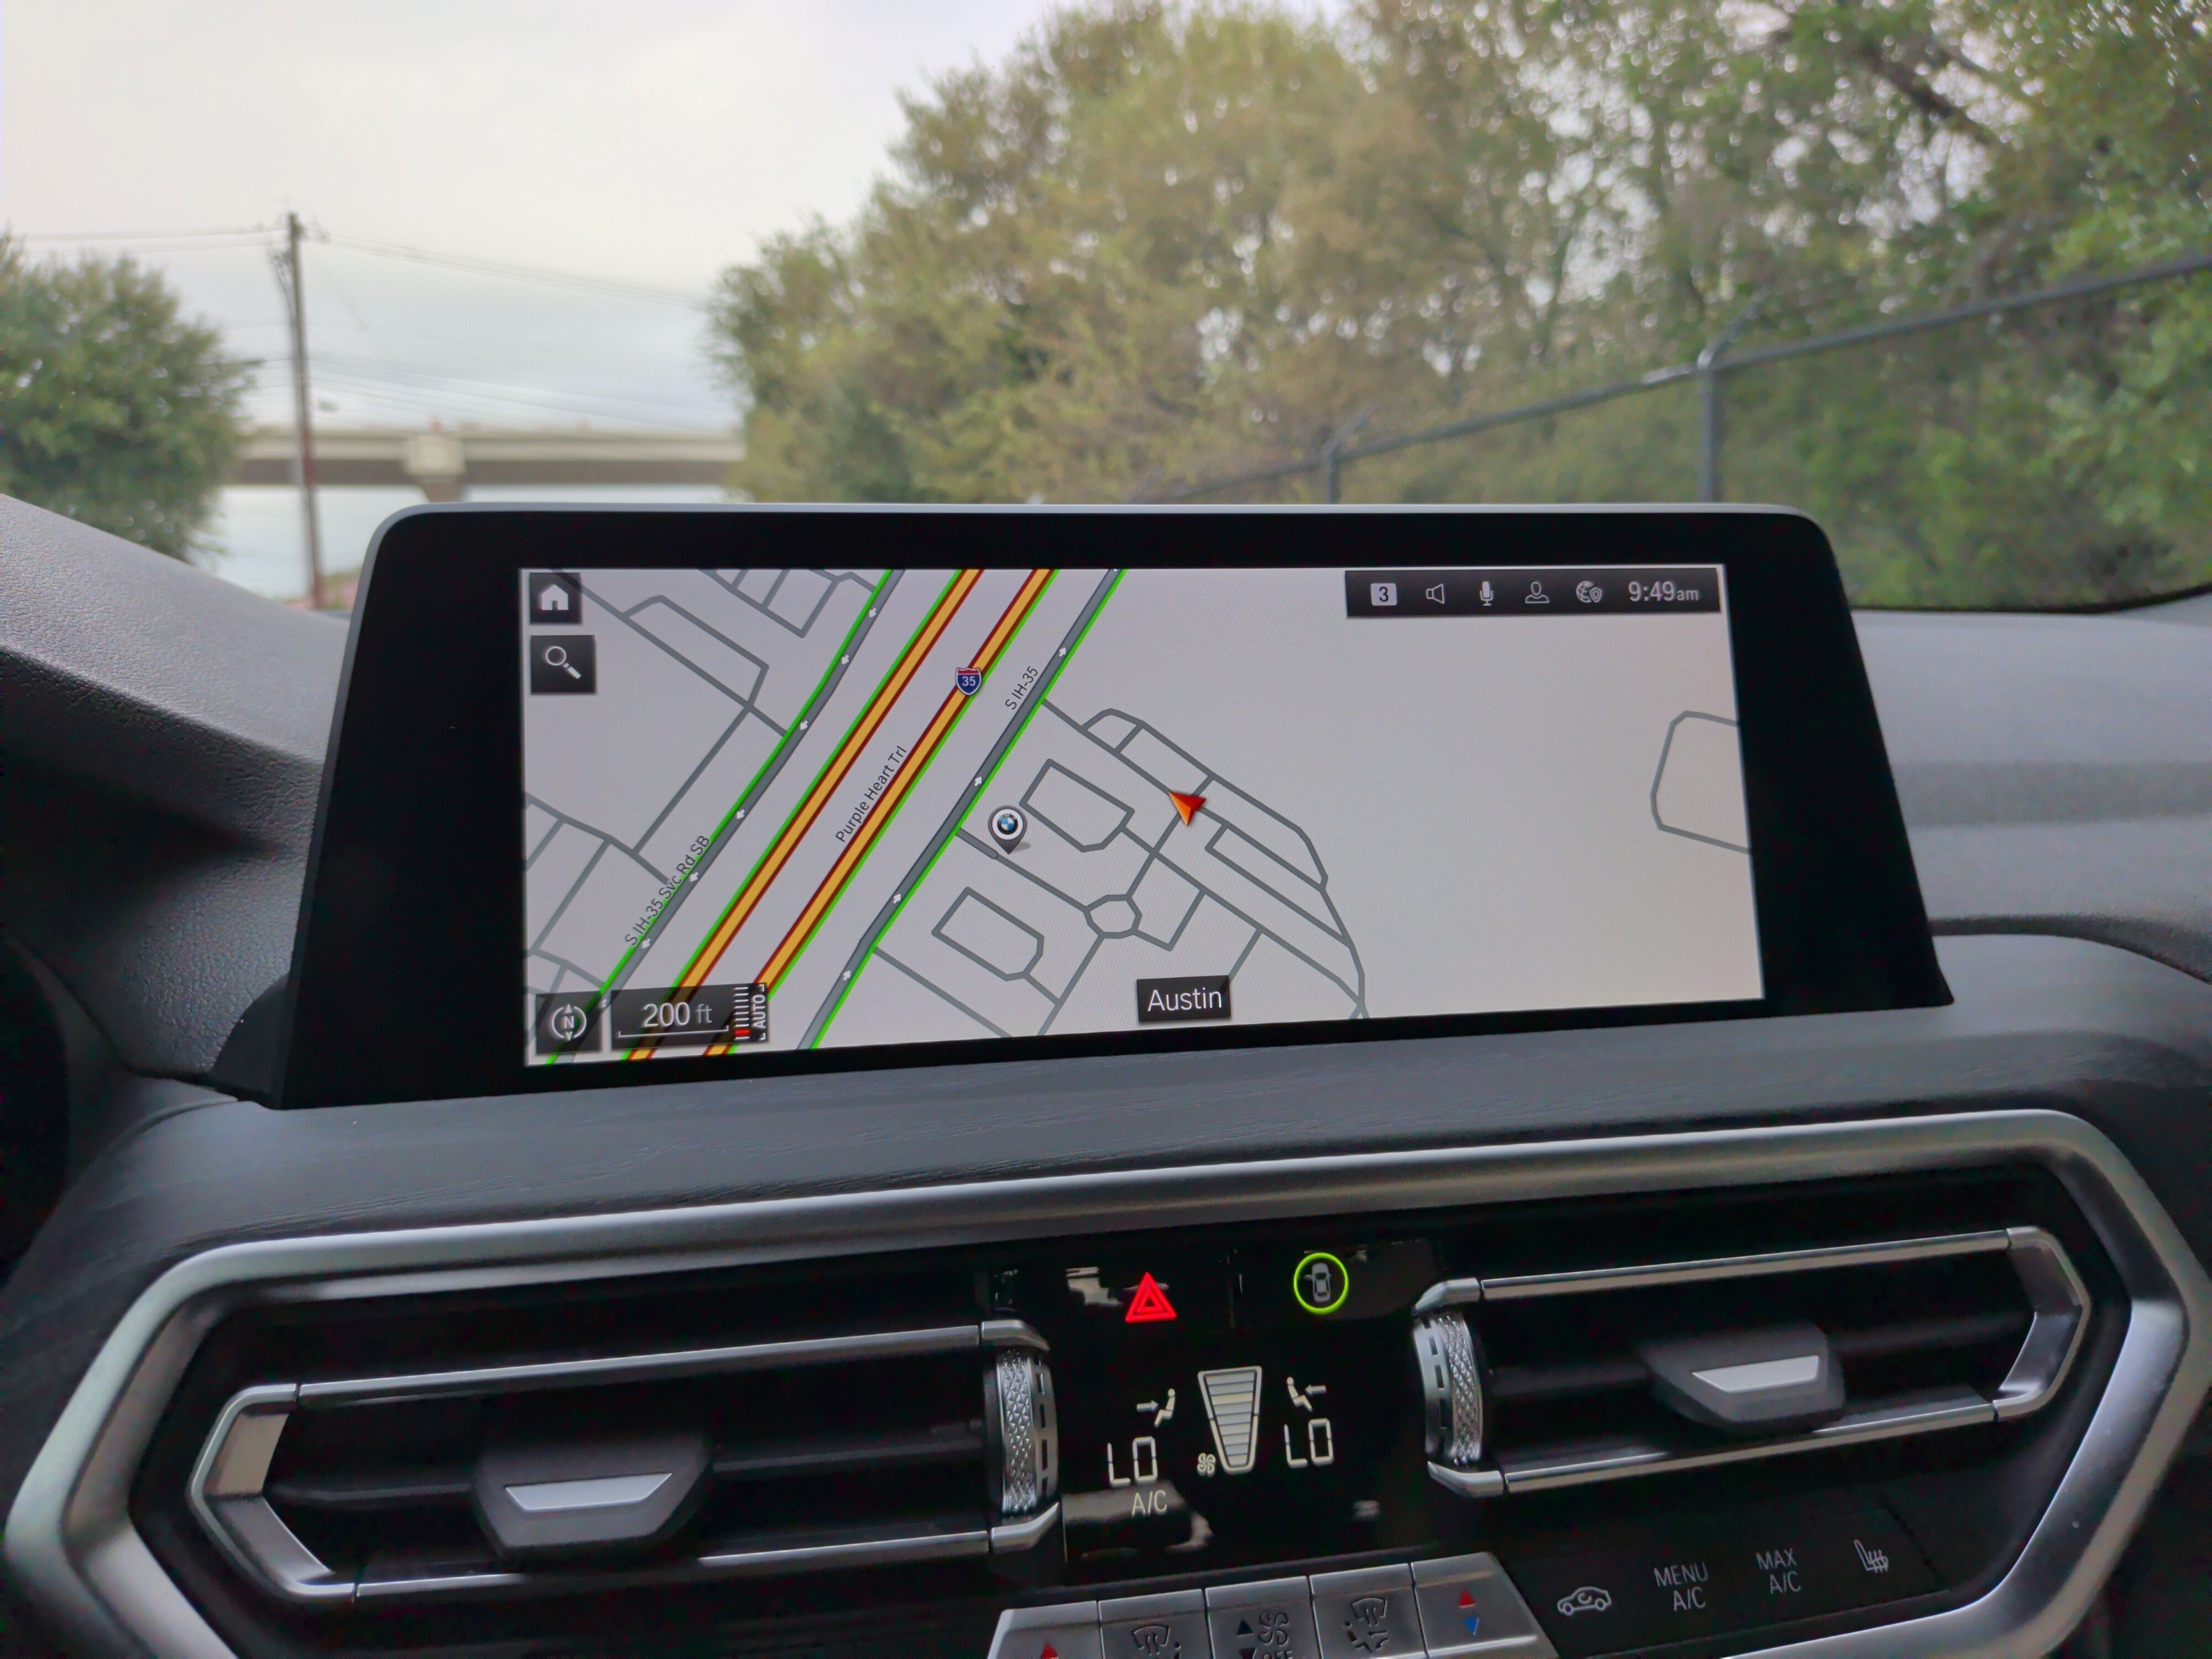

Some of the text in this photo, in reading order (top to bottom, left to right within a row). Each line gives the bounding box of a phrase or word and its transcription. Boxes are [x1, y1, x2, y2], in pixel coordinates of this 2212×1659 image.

[1379, 586, 1389, 602] 3
[962, 676, 975, 686] 35
[1005, 666, 1038, 710] S IH-35
[835, 745, 907, 843] Purple Heart Trl
[625, 836, 709, 946] S IH-35 Svc Rd SB
[753, 994, 766, 1029] AUTO
[1147, 987, 1222, 1011] Austin
[564, 1016, 574, 1029] N
[642, 1002, 712, 1027] 200 ft
[1131, 1490, 1168, 1517] A/C
[1756, 1548, 1797, 1571] MAX
[1653, 1562, 1708, 1587] MENU
[1770, 1571, 1801, 1594] A/C
[1673, 1586, 1706, 1612] A/C
